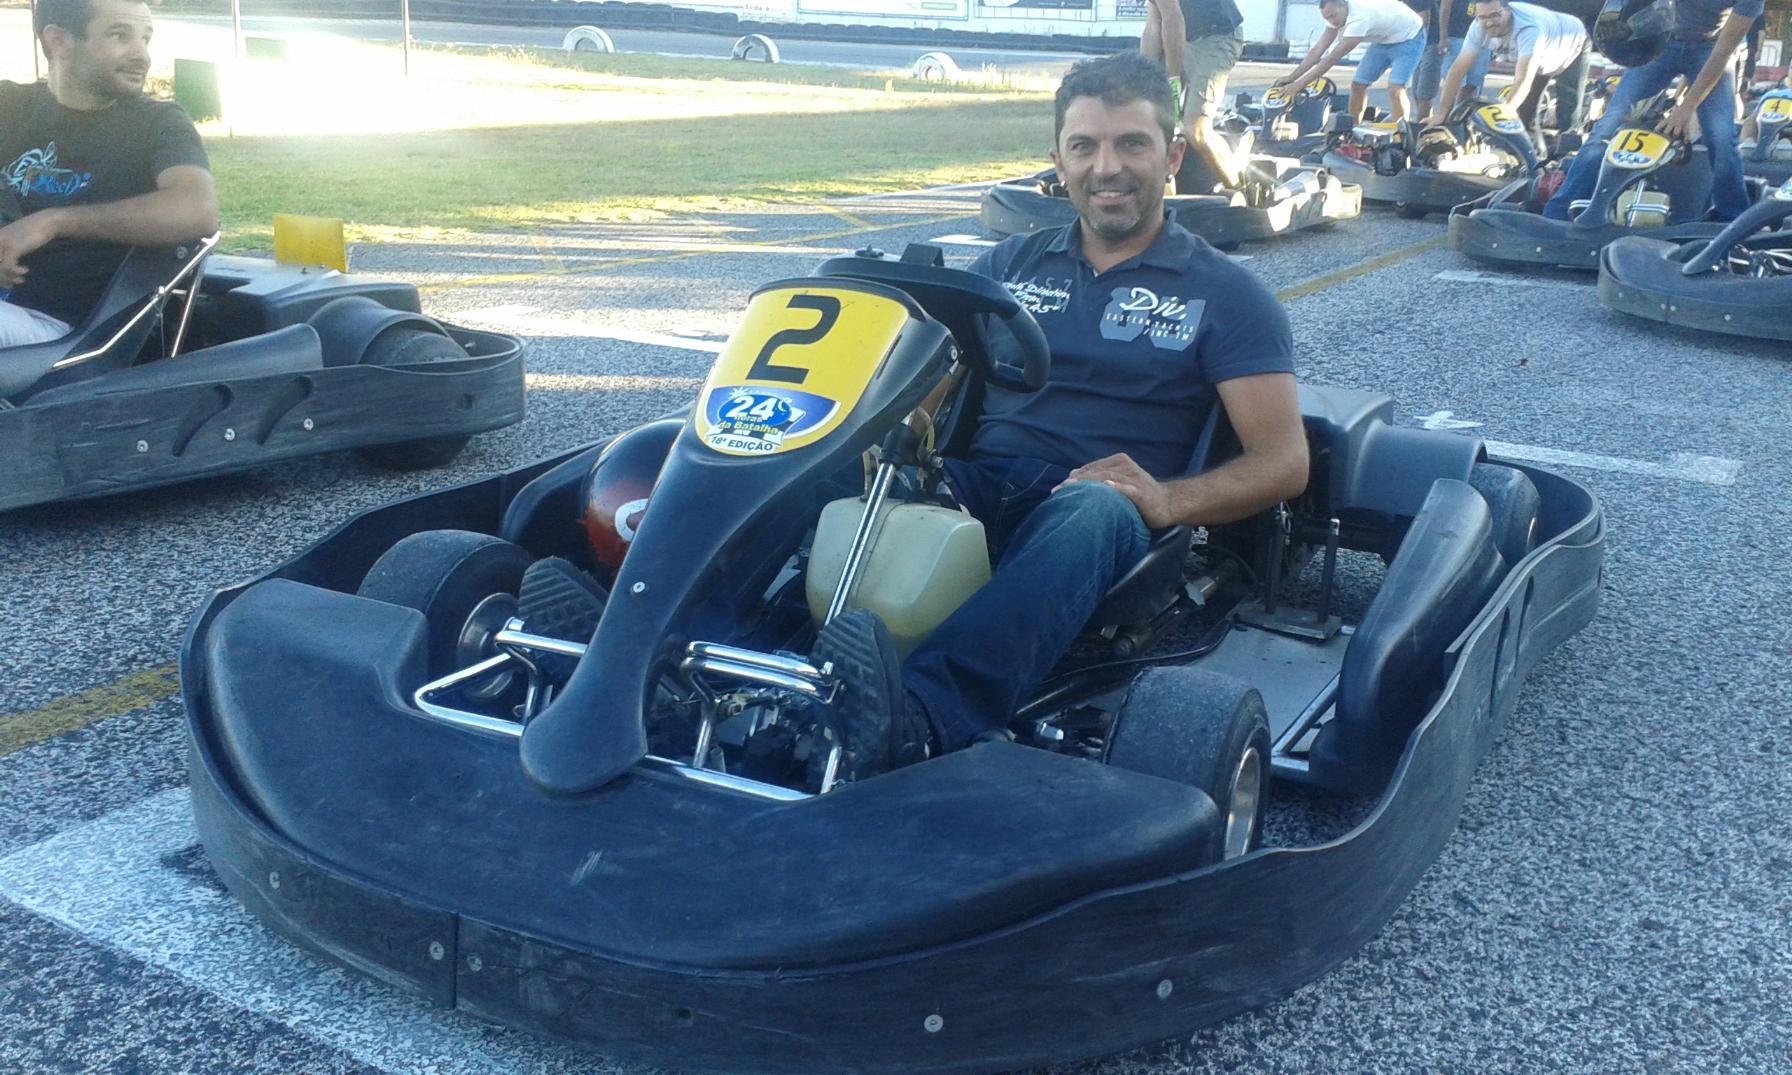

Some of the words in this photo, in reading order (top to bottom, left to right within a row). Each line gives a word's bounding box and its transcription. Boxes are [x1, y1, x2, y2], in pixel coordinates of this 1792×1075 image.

[1486, 106, 1508, 122] 2
[1618, 131, 1651, 153] 15
[745, 294, 842, 385] 2
[725, 395, 779, 421] 24
[718, 421, 732, 430] da
[733, 420, 780, 437] Batalha
